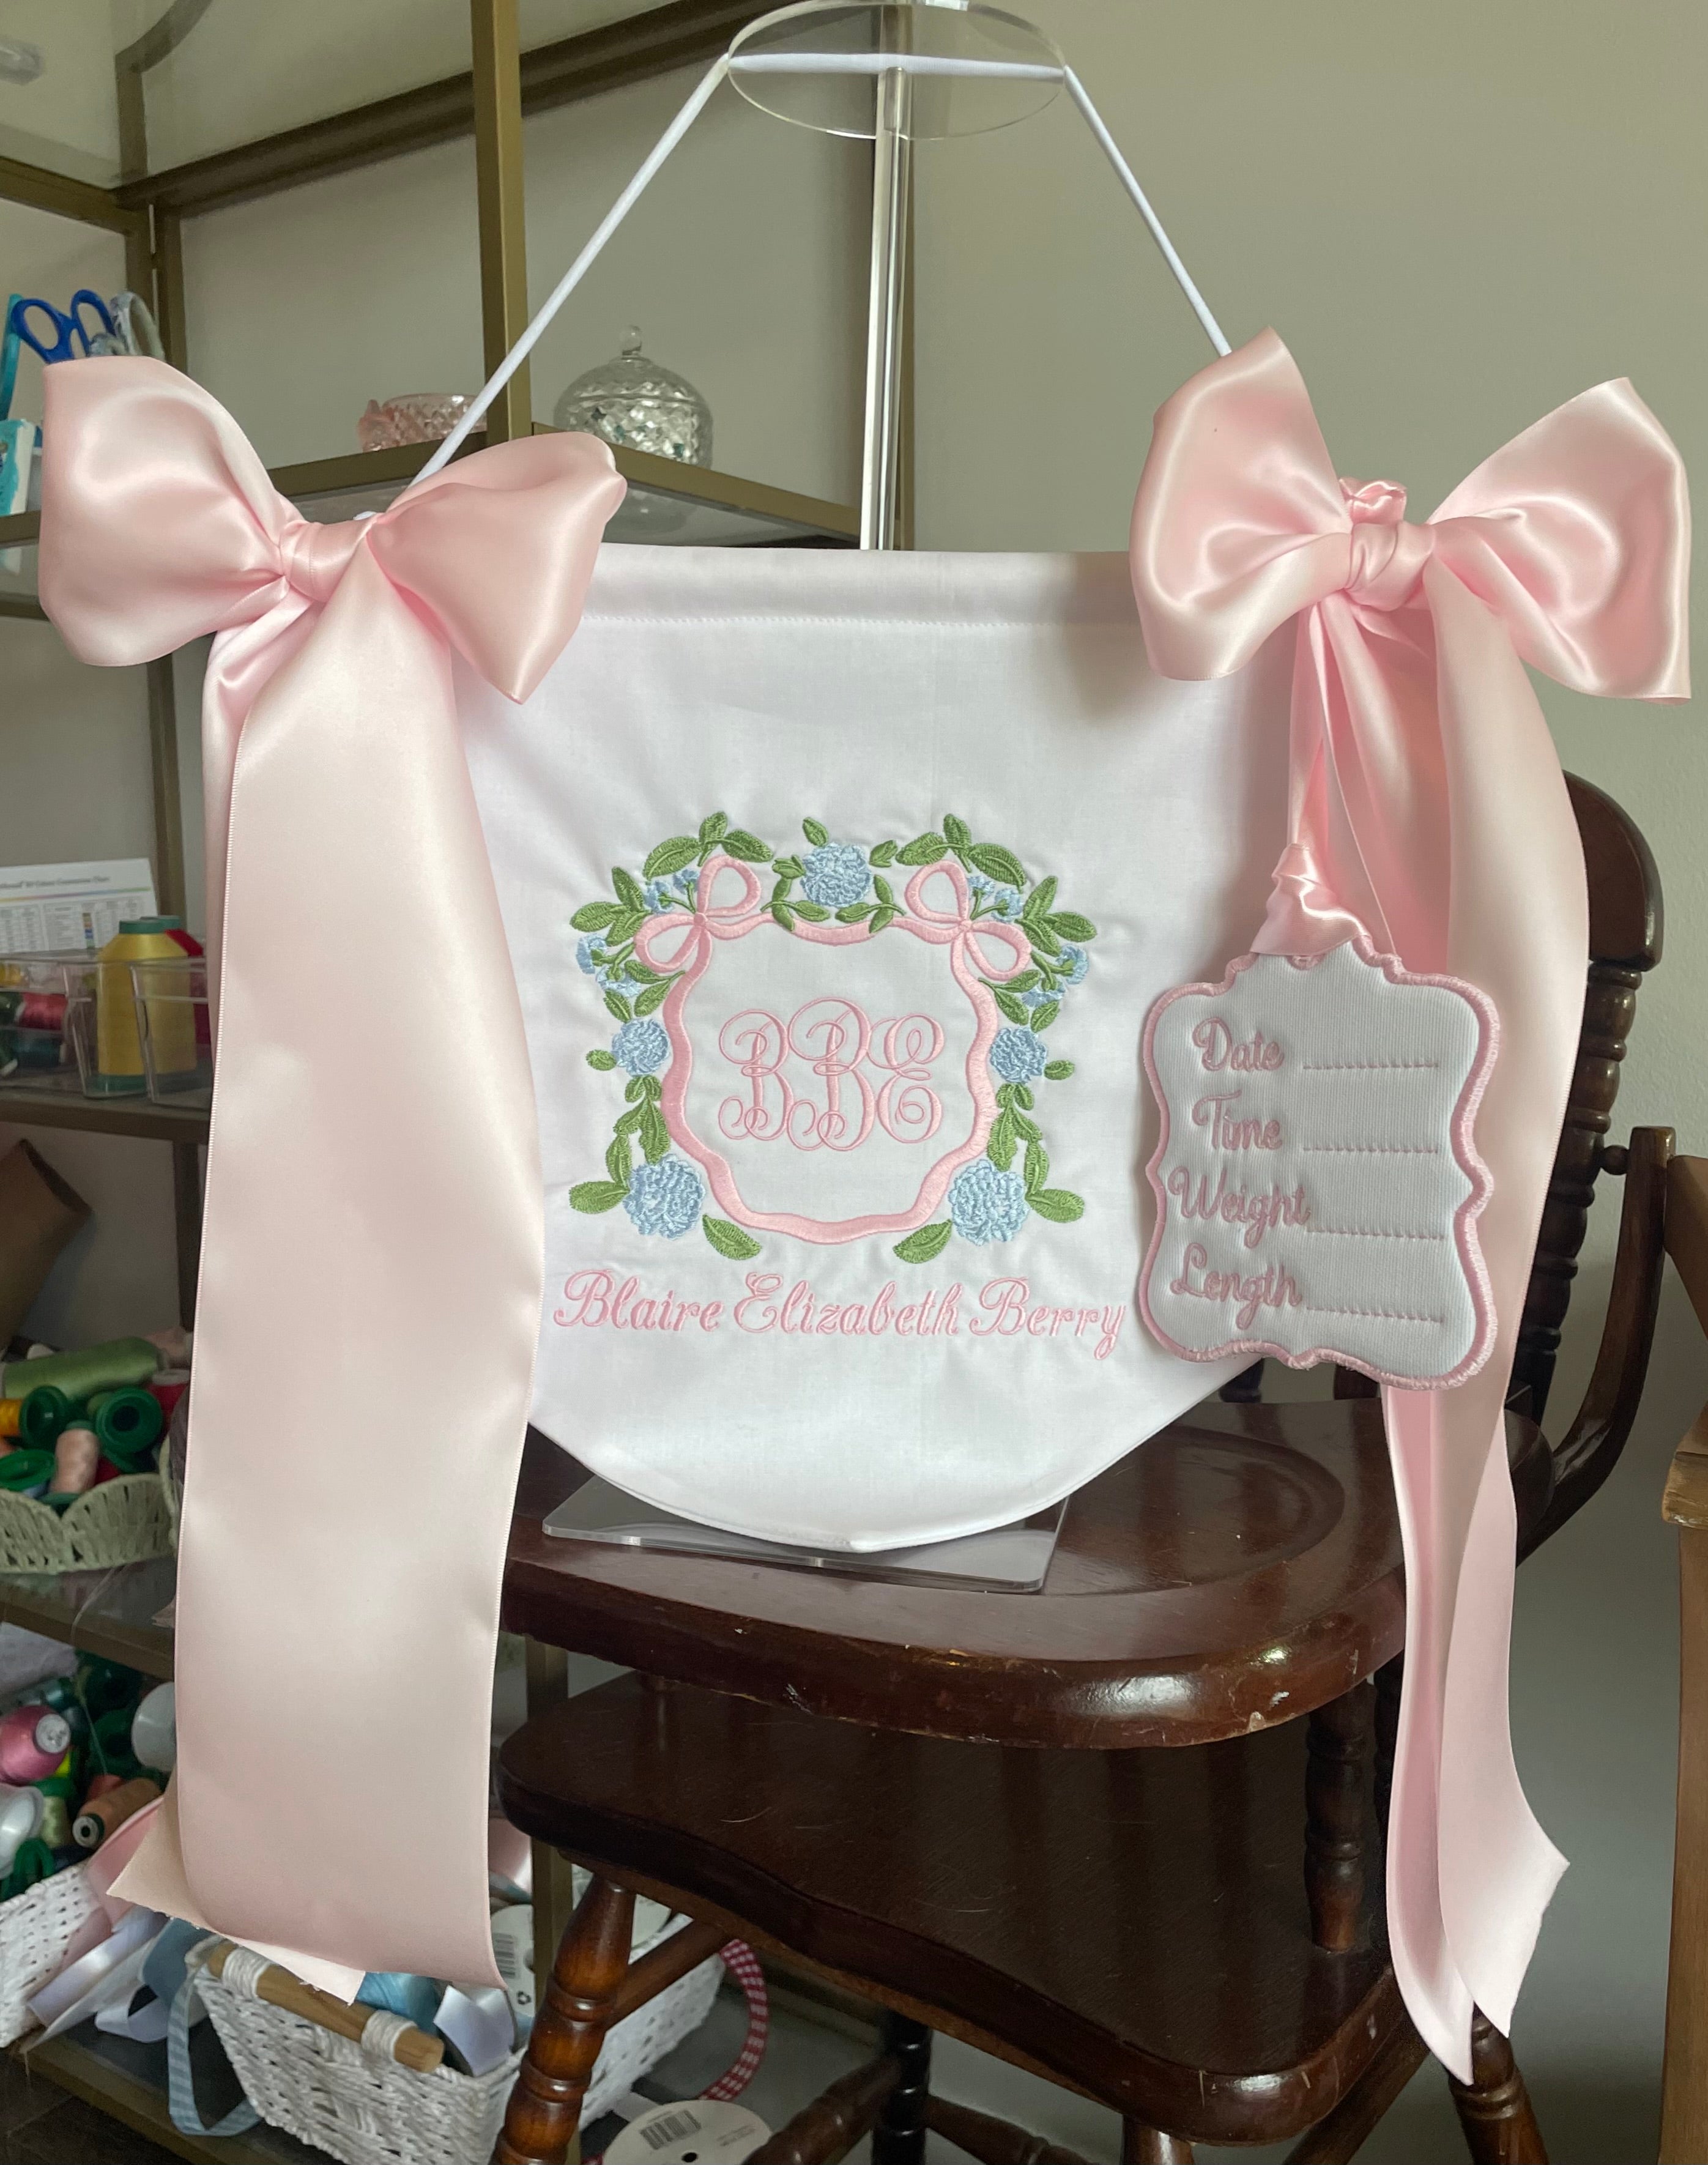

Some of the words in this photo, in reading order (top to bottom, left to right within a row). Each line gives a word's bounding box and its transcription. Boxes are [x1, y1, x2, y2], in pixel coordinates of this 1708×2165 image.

[1193, 1017, 1285, 1072] Date
[1192, 1090, 1282, 1150] Time
[1168, 1167, 1311, 1248] Weight
[554, 1269, 724, 1332] Blaire
[734, 1273, 962, 1335] Elizabeth
[969, 1277, 1126, 1360] Berry
[1170, 1242, 1302, 1329] Length
